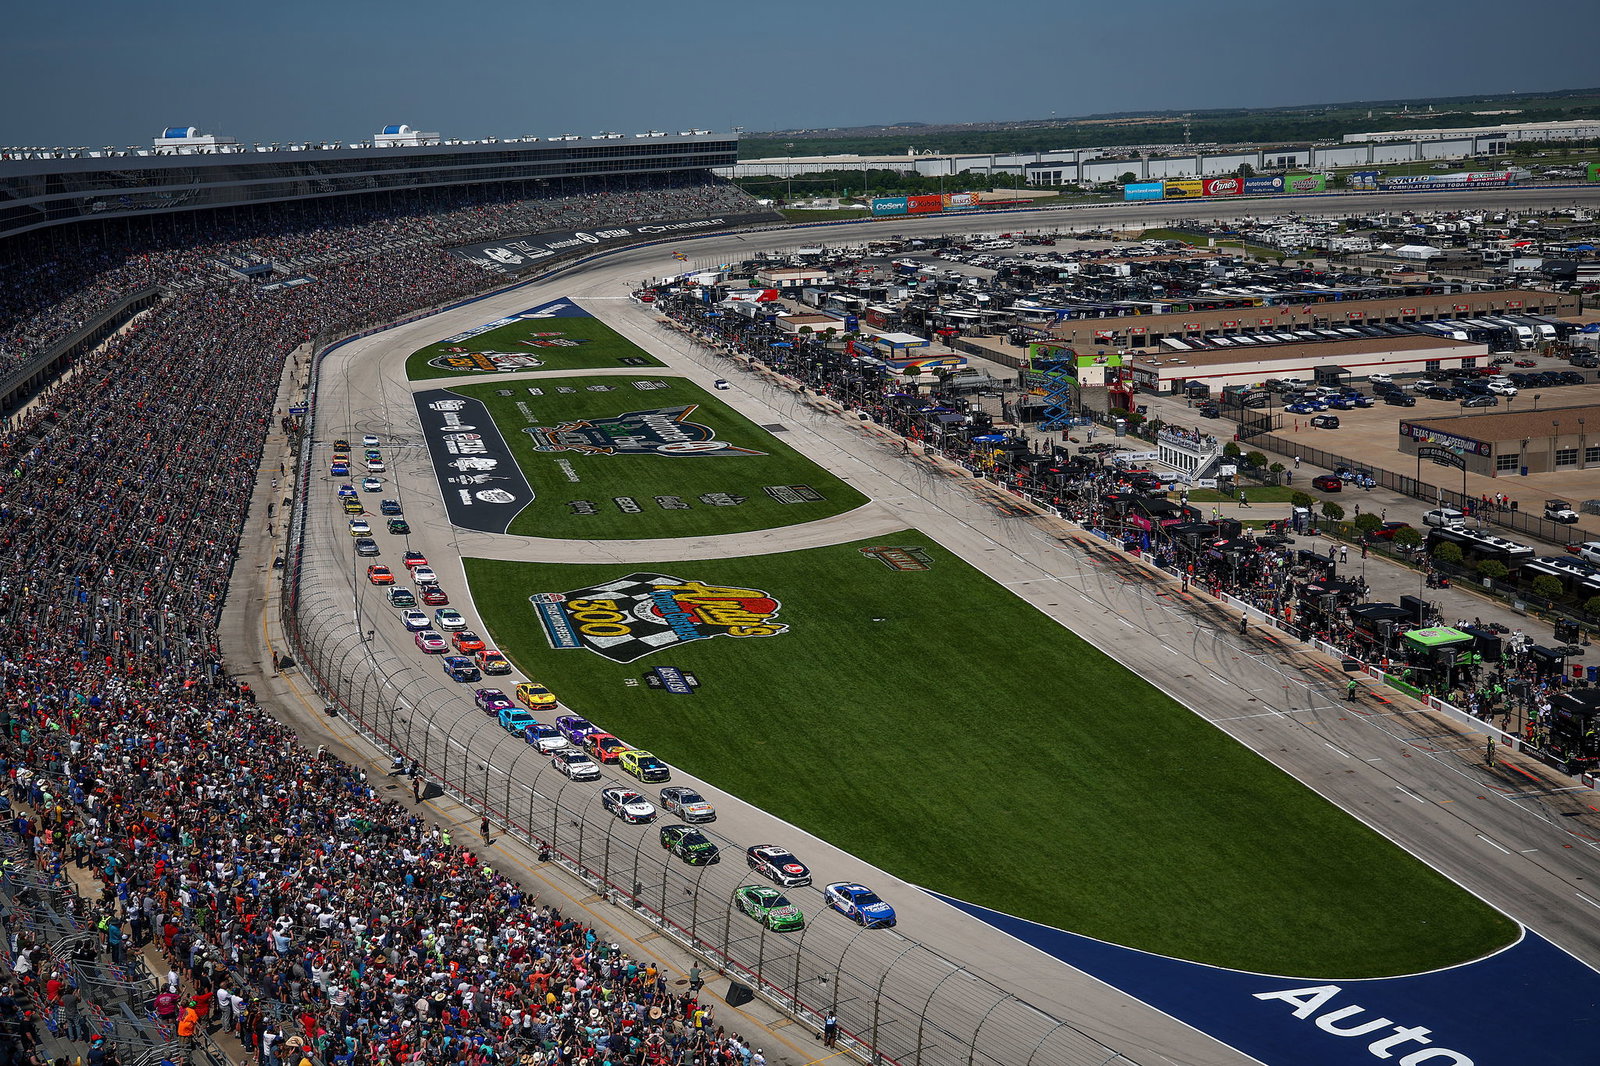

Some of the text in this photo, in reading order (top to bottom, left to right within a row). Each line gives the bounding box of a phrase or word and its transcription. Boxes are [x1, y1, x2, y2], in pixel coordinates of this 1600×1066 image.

[1210, 180, 1238, 193] Cane's
[664, 218, 726, 231] CHEVROLET
[1412, 427, 1429, 439] TEXAS
[1447, 436, 1477, 452] SPEEDWAY
[567, 599, 632, 637] 300
[650, 590, 709, 641] Frozen Custard
[652, 582, 787, 637] Andy's
[1251, 984, 1475, 1066] Auto
